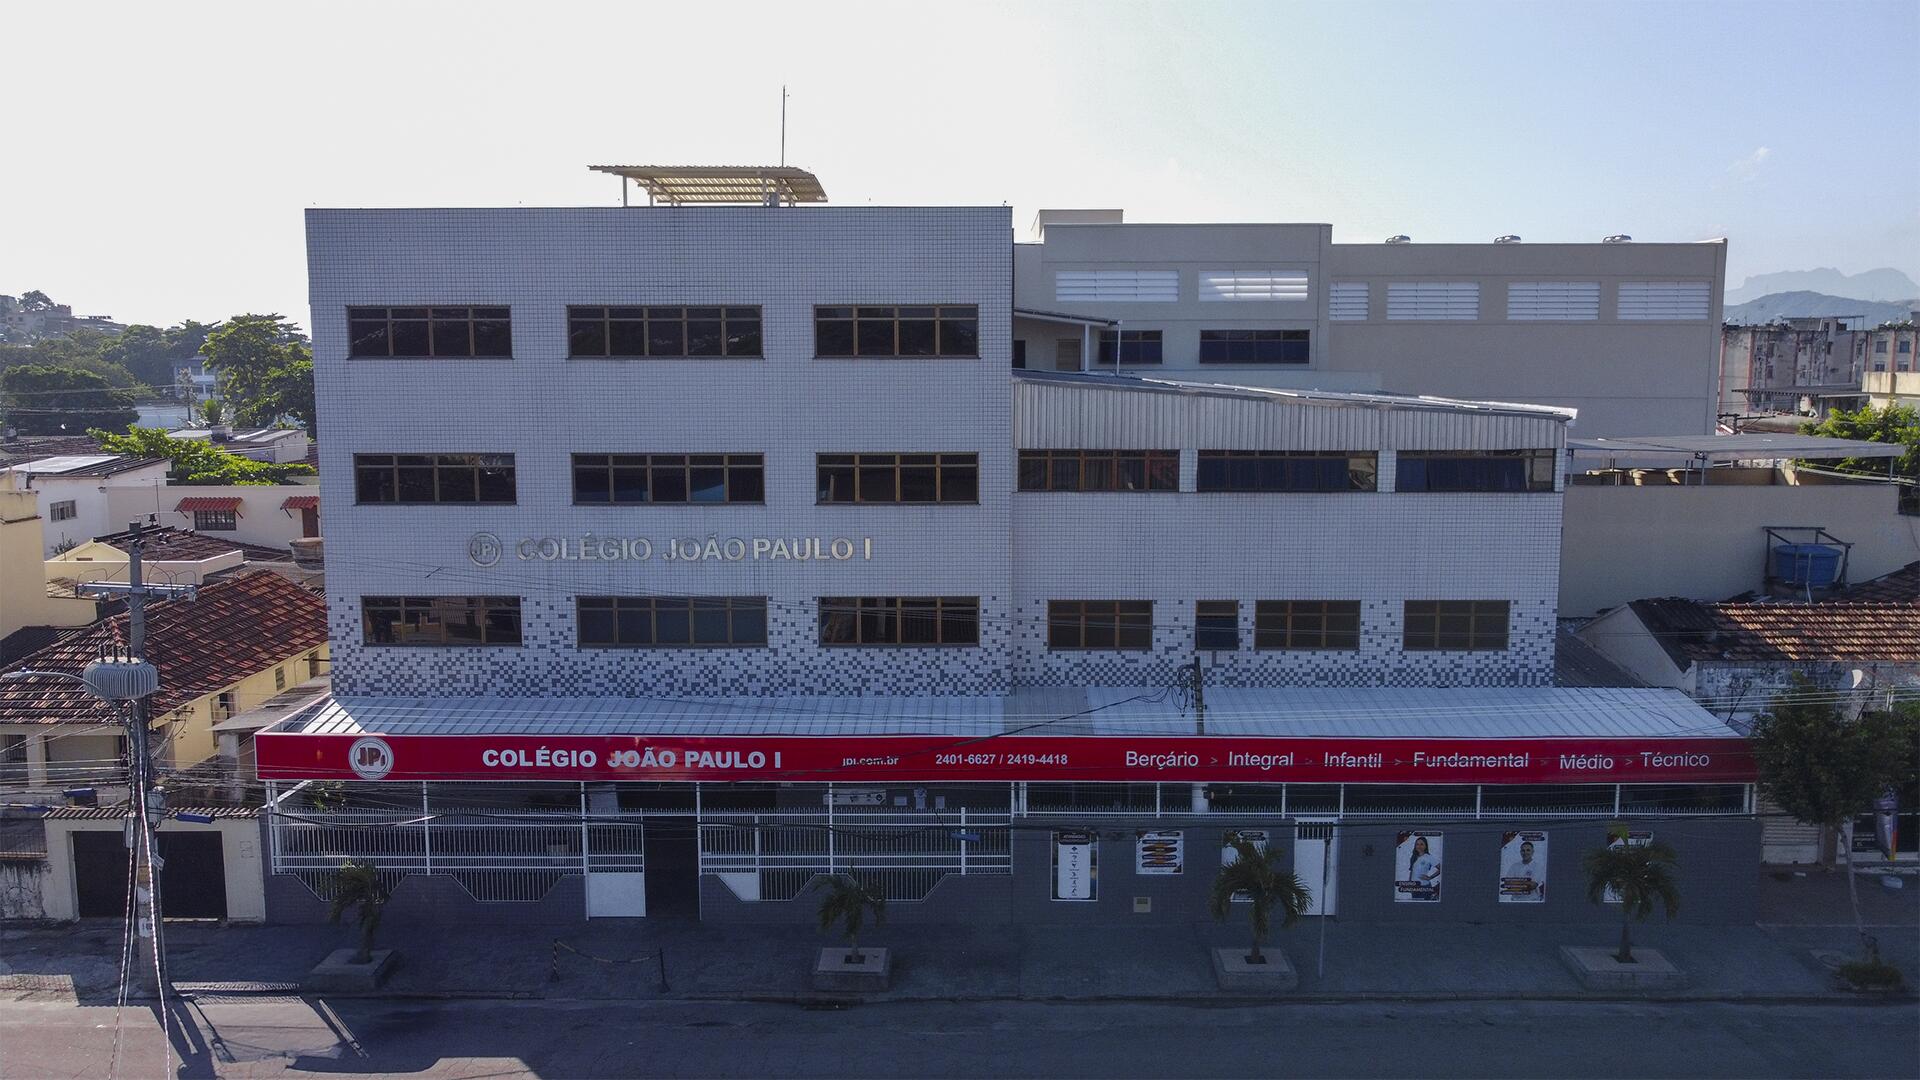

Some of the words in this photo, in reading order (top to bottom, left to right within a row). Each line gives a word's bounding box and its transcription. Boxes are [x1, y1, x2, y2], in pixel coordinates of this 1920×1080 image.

[516, 532, 653, 561] COLÉGIO
[662, 532, 746, 561] JOÃO
[753, 538, 854, 561] PAULO
[865, 538, 872, 560] I
[482, 746, 597, 768] COLÉGIO
[607, 747, 677, 768] JOÃO
[684, 750, 766, 769] PAULO
[774, 751, 782, 768] I
[842, 755, 899, 768] jpi.com.br
[935, 753, 996, 765] 2401-6627
[1007, 753, 1068, 765] 2419-4418
[1125, 750, 1199, 770] Berçário
[1228, 751, 1294, 770] Integral
[1324, 751, 1382, 769] Infantil
[1413, 751, 1529, 768] Fundamental
[1559, 753, 1614, 770] Médio
[1640, 751, 1710, 768] Técnico
